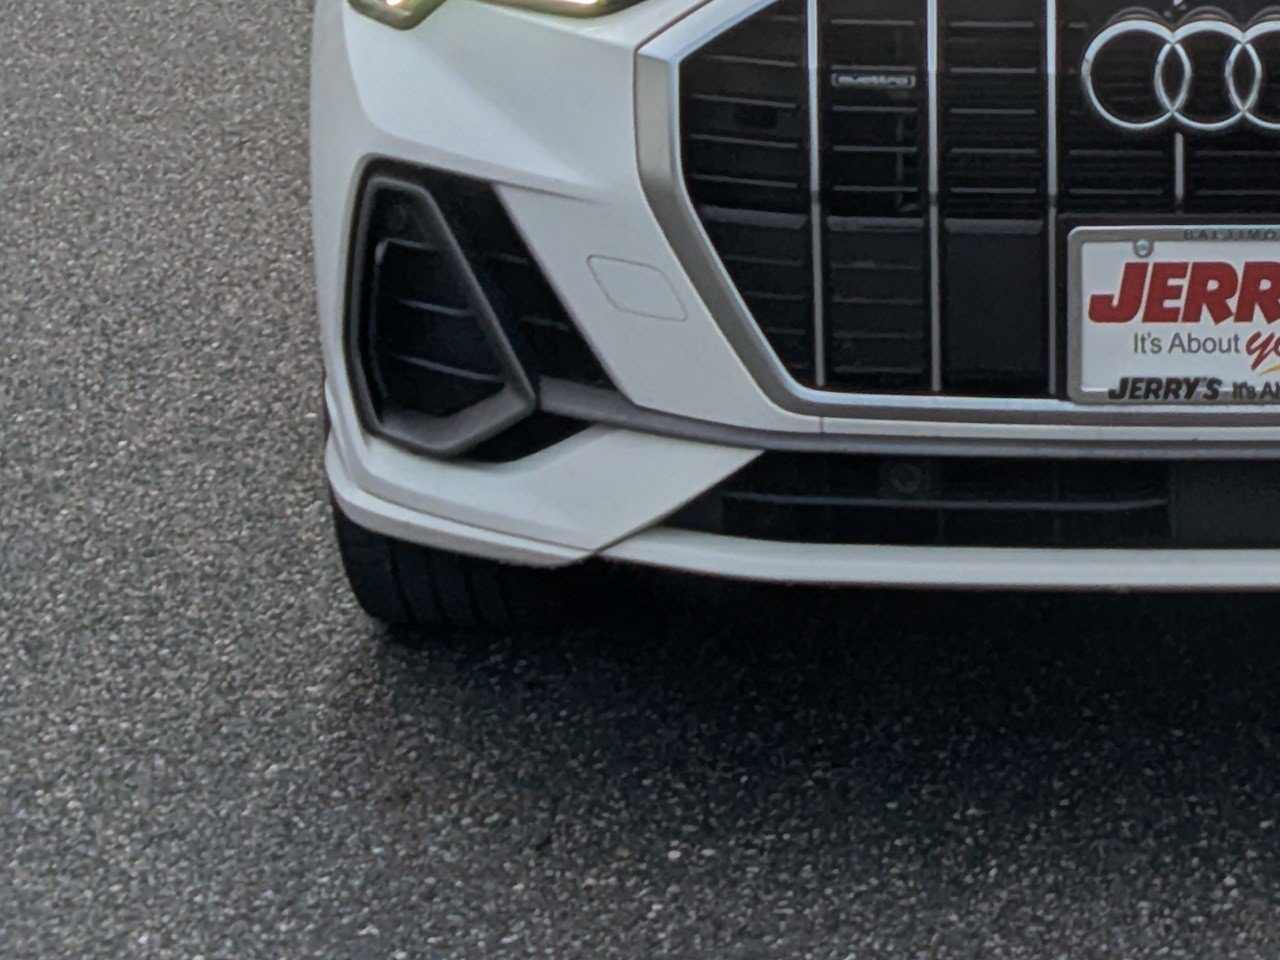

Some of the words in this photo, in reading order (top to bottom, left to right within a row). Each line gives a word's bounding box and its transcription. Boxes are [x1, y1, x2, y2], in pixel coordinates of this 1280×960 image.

[1133, 332, 1163, 354] It's
[1168, 331, 1242, 354] About
[1107, 376, 1224, 400] JERRY'S
[1231, 381, 1256, 399] It's
